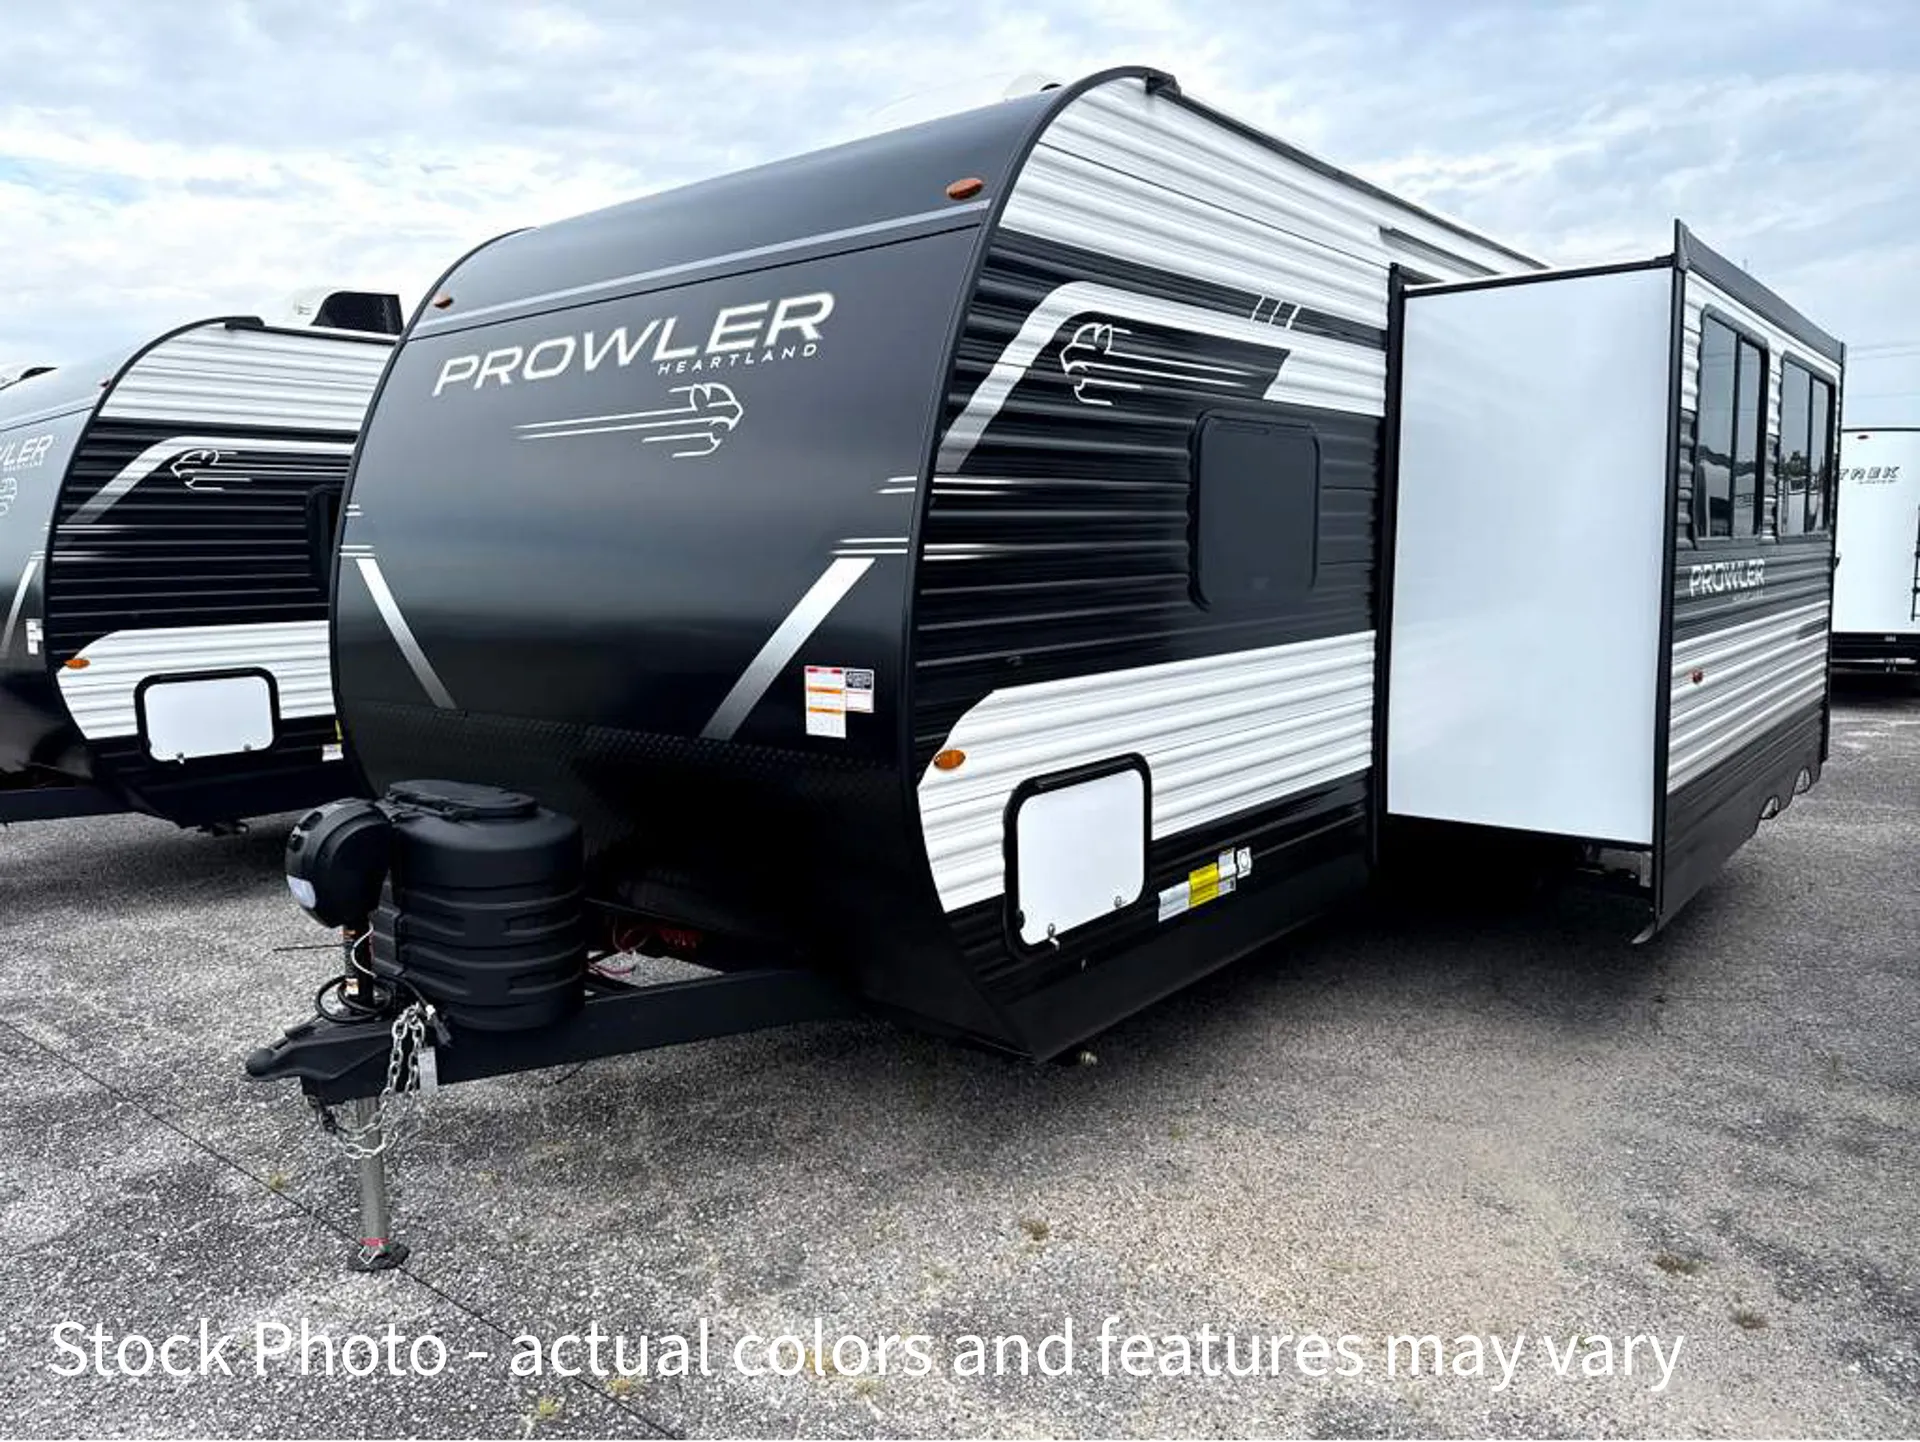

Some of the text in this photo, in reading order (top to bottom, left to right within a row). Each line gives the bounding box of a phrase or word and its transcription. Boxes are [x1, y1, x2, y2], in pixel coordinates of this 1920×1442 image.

[432, 292, 835, 397] PROWLER
[657, 343, 818, 376] HEARTLAND
[1689, 558, 1765, 597] PROWLER
